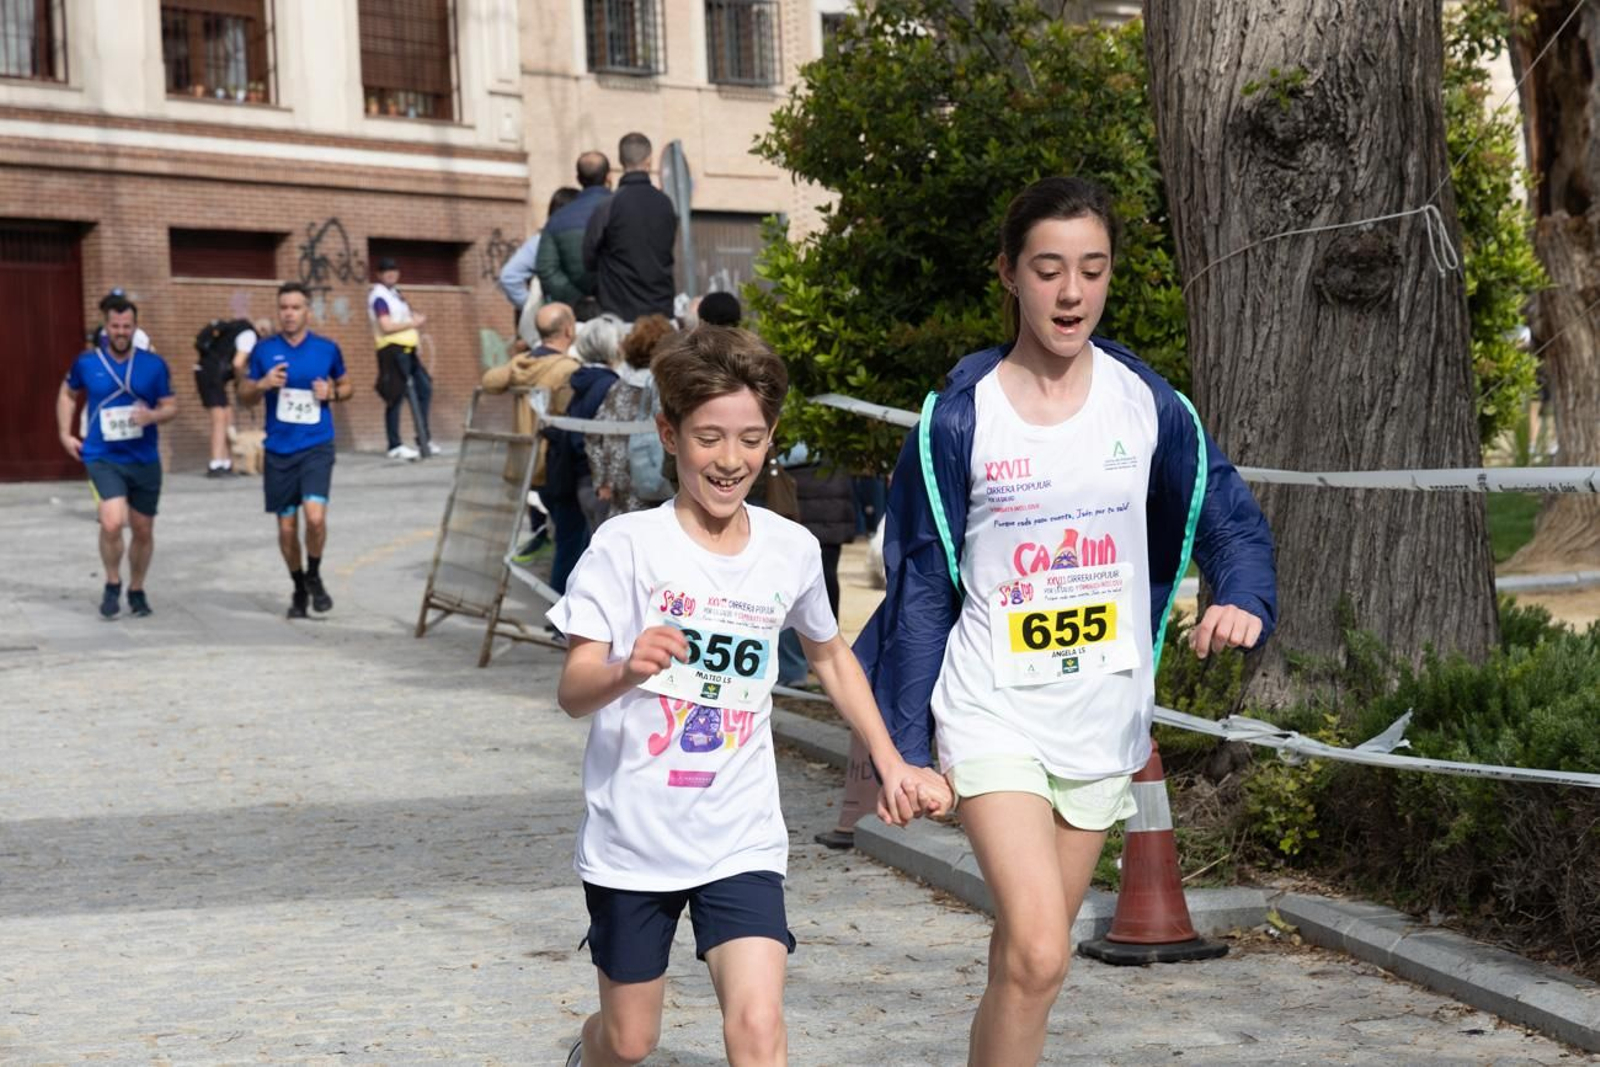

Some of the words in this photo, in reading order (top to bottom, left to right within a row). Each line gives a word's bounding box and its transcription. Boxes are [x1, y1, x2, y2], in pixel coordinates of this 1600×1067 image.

[287, 400, 312, 414] 745
[985, 458, 1032, 481] XXVII
[987, 485, 1015, 495] CARRERA
[1016, 480, 1052, 492] POPULAR
[1093, 570, 1119, 580] POPULAR
[728, 600, 755, 612] CARRERA
[1022, 605, 1108, 650] 655
[673, 629, 763, 677] 656
[1051, 649, 1077, 658] ANGELA
[1078, 648, 1086, 656] LS
[695, 671, 722, 683] MATEO
[723, 674, 732, 684] LS
